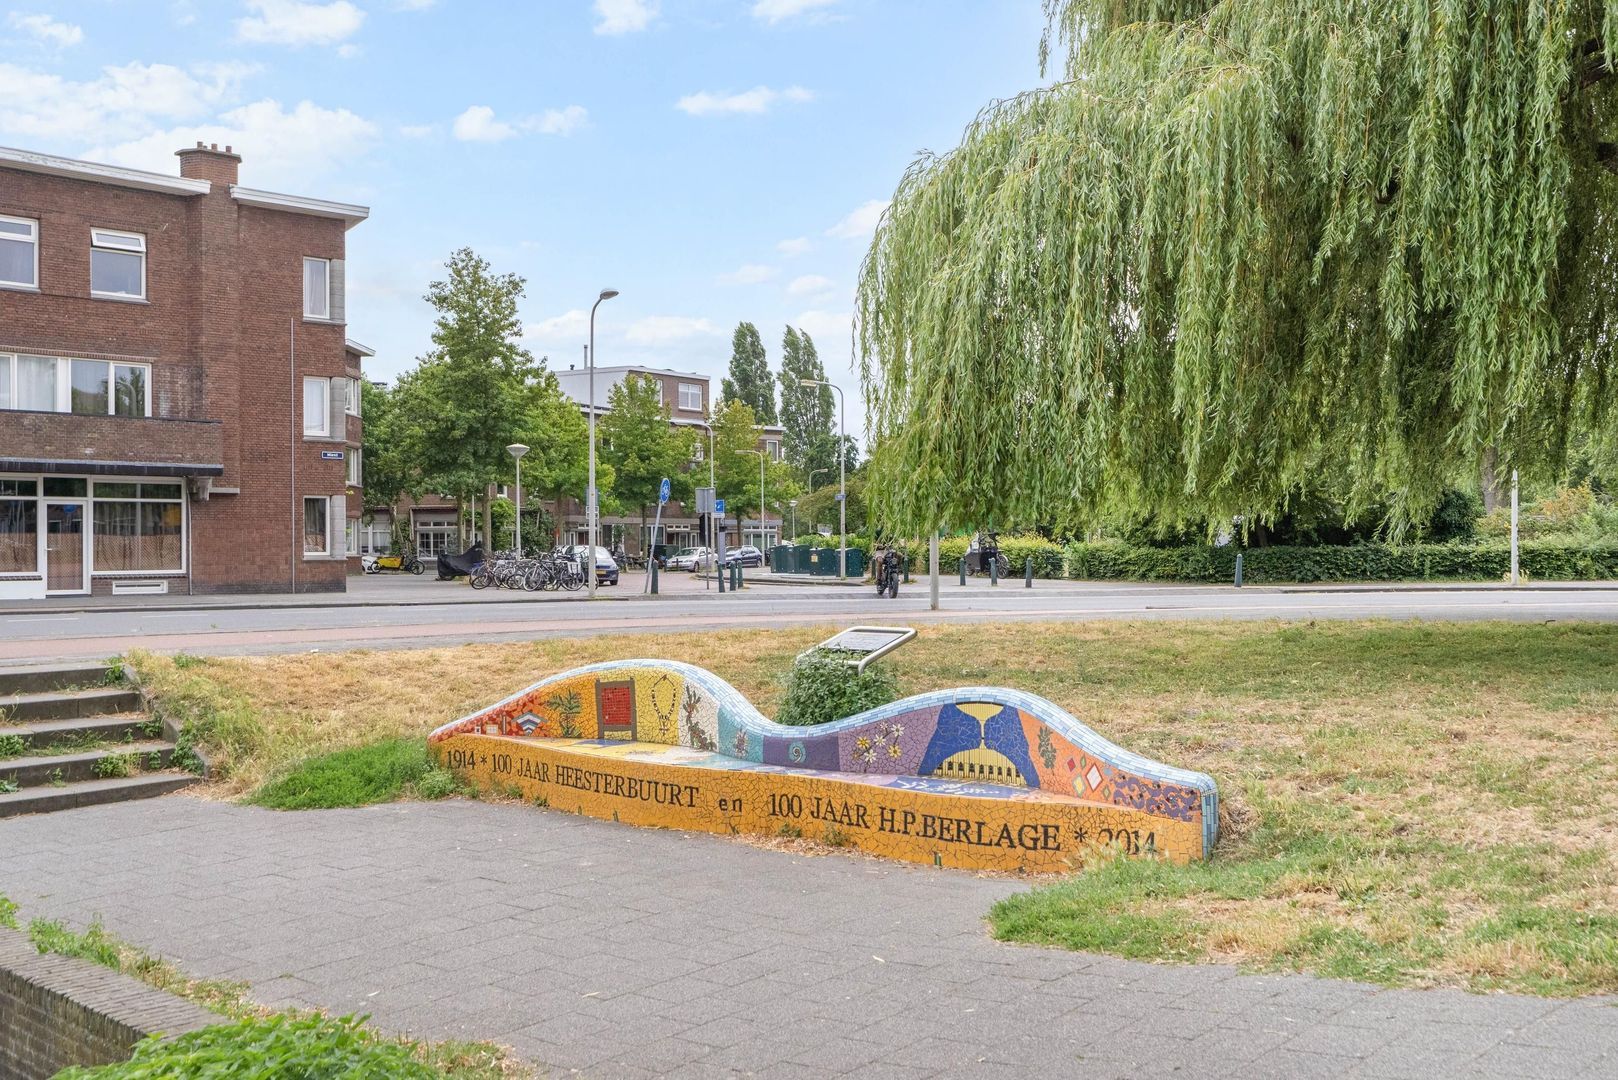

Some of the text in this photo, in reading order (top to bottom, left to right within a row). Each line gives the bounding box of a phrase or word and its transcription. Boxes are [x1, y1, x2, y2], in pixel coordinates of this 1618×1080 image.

[446, 750, 476, 771] 1914
[491, 753, 512, 775] 100
[516, 757, 551, 783] JAAR
[555, 764, 699, 808] HEESTERBUURT
[718, 796, 742, 813] en
[768, 793, 803, 819] 100
[810, 796, 870, 829] JAAR
